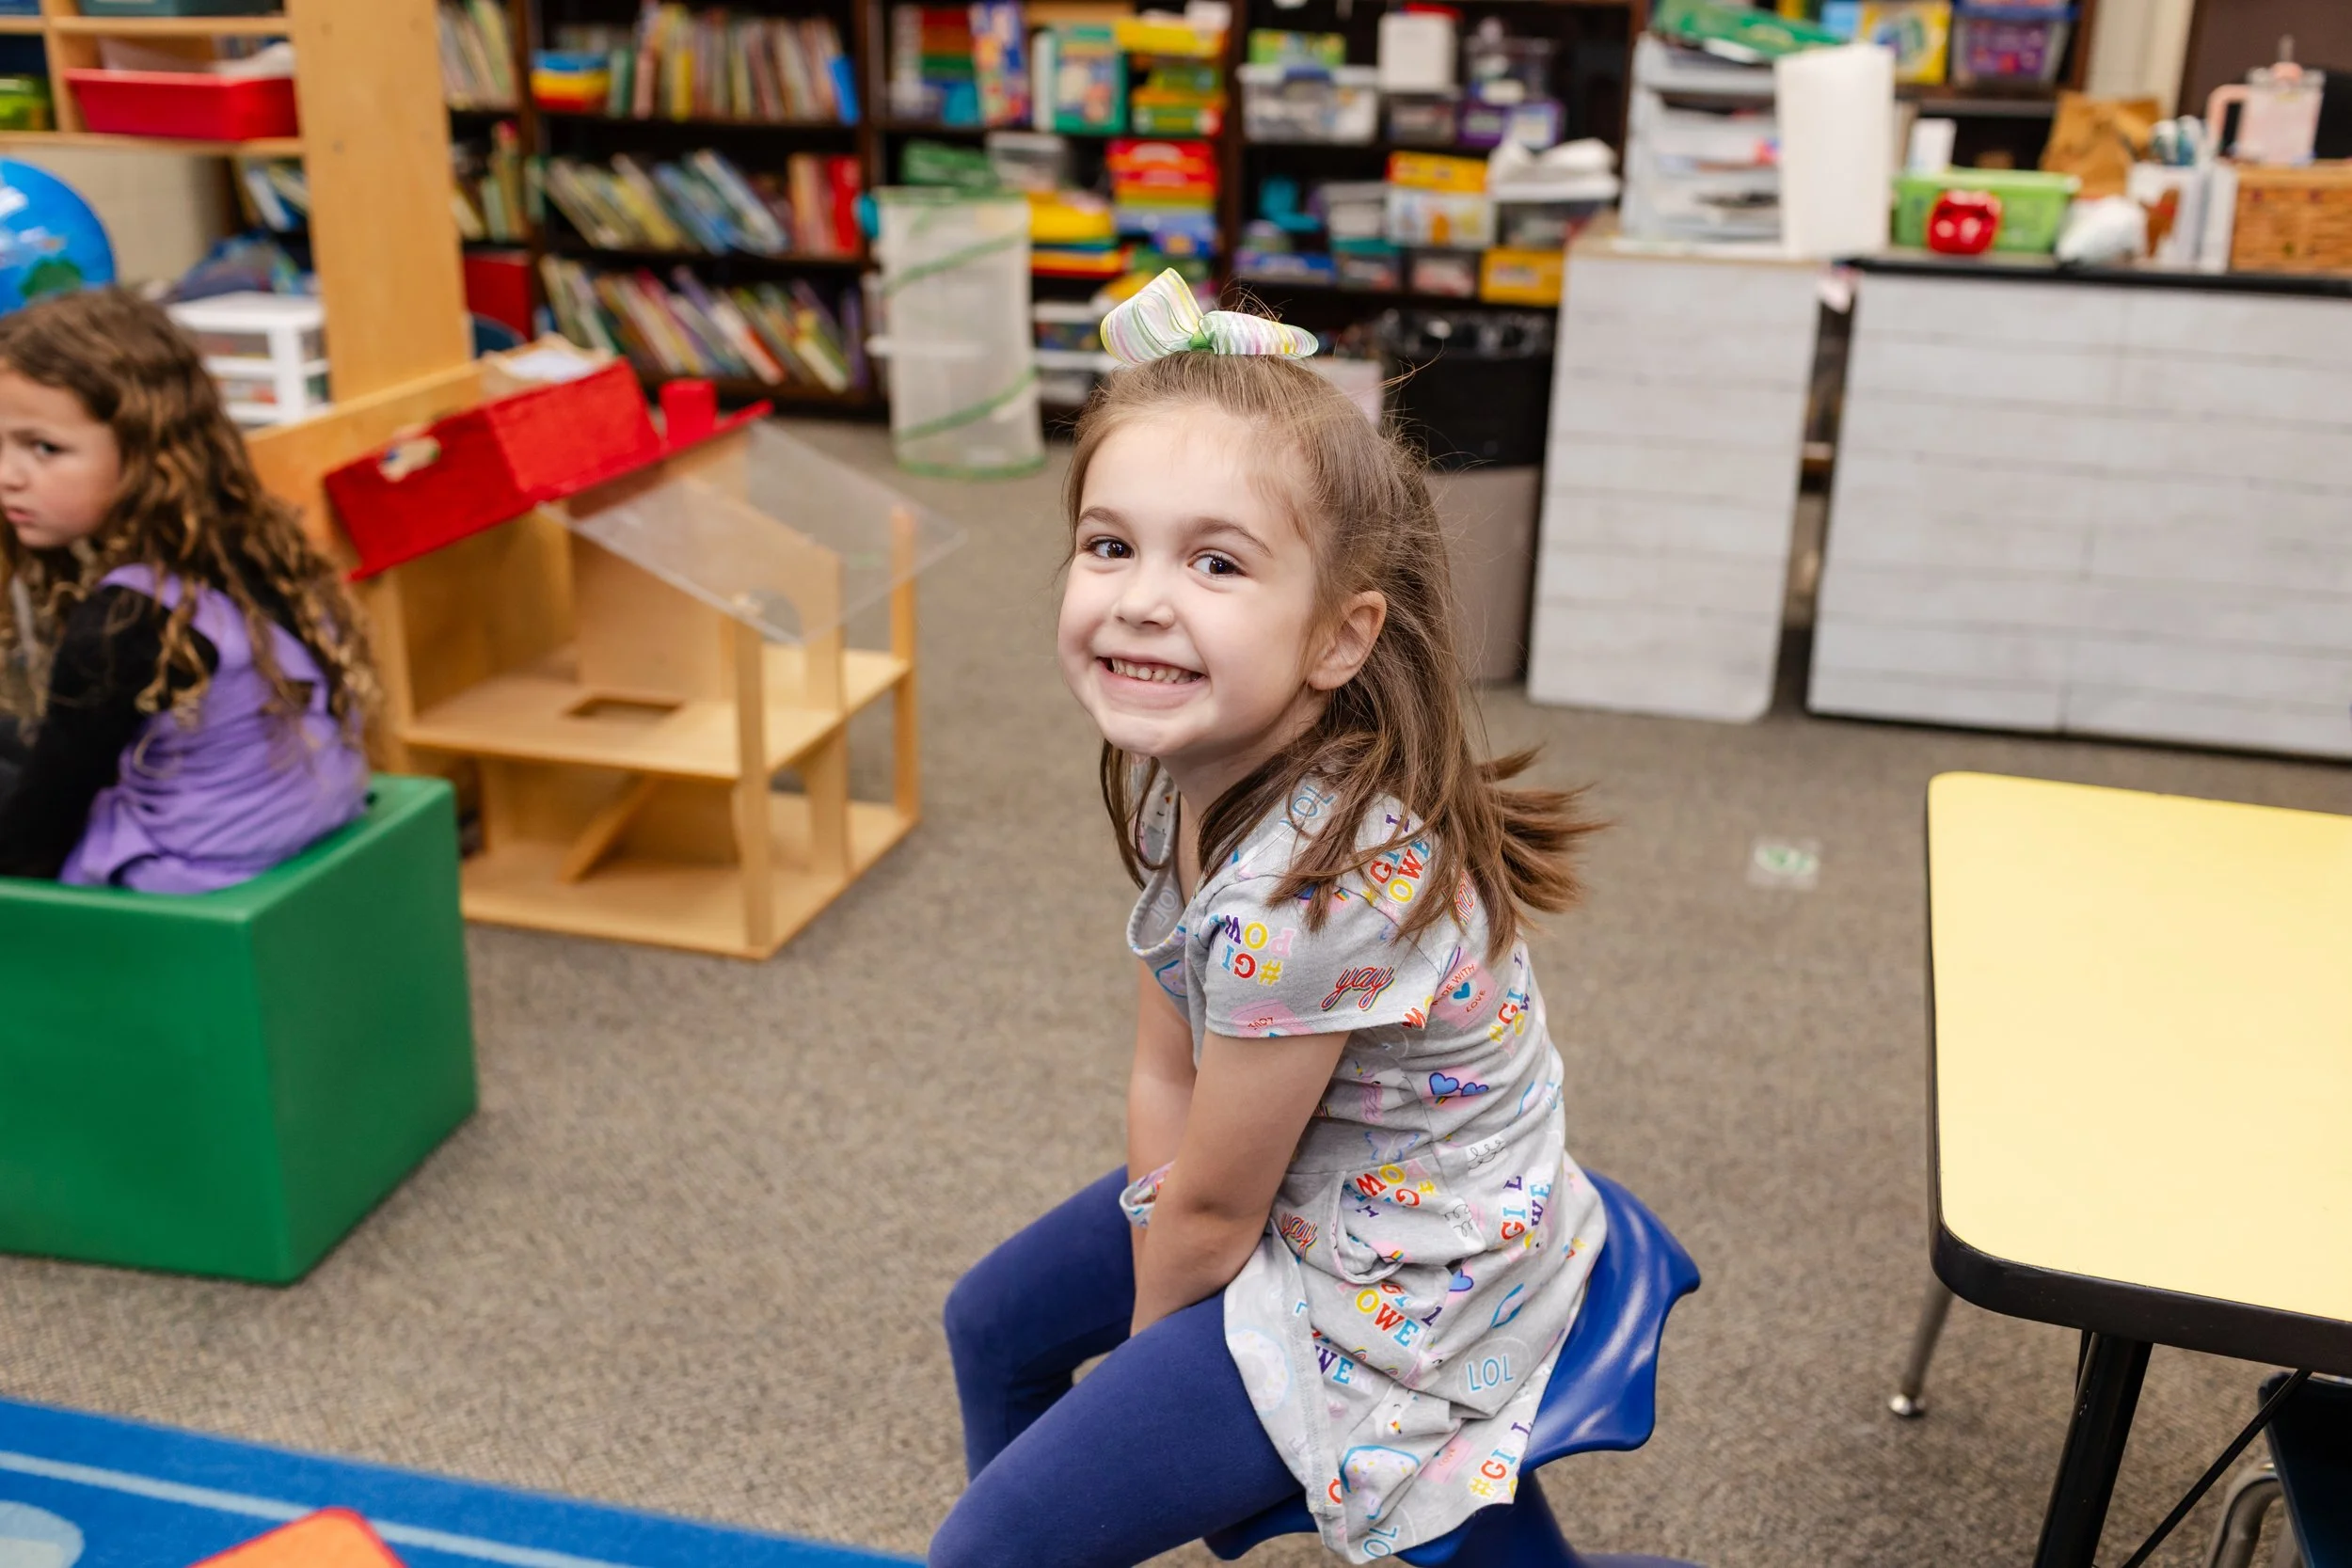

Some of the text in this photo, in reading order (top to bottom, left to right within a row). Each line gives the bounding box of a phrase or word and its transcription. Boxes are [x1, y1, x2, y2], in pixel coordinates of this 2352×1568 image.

[1321, 967, 1395, 1012] yay
[1452, 964, 1475, 983] WITH
[1466, 990, 1486, 1012] LOVE
[1280, 1213, 1318, 1262] yay
[1468, 1354, 1514, 1391] LOL
